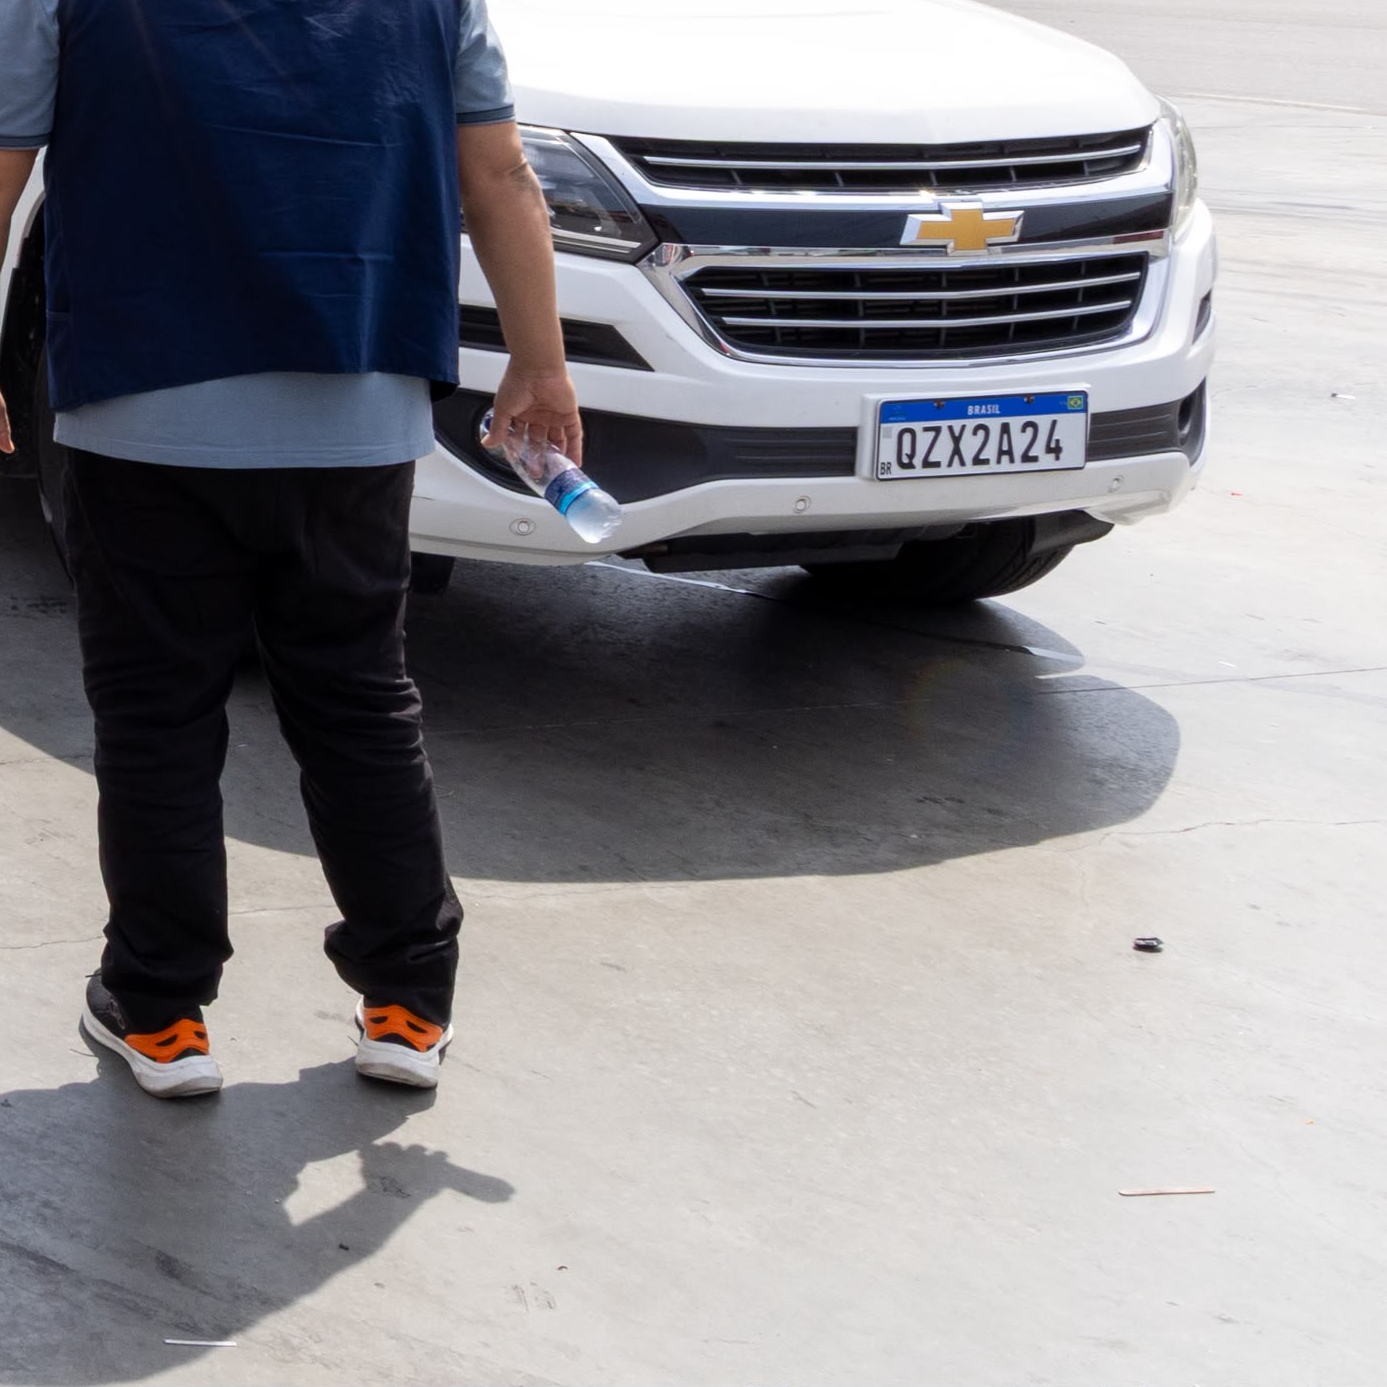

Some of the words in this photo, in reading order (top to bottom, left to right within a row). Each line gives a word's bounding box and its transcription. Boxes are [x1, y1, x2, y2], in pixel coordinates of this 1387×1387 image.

[967, 404, 1001, 416] BRASIL
[896, 419, 1063, 470] QZX2A24
[880, 461, 892, 476] BR
